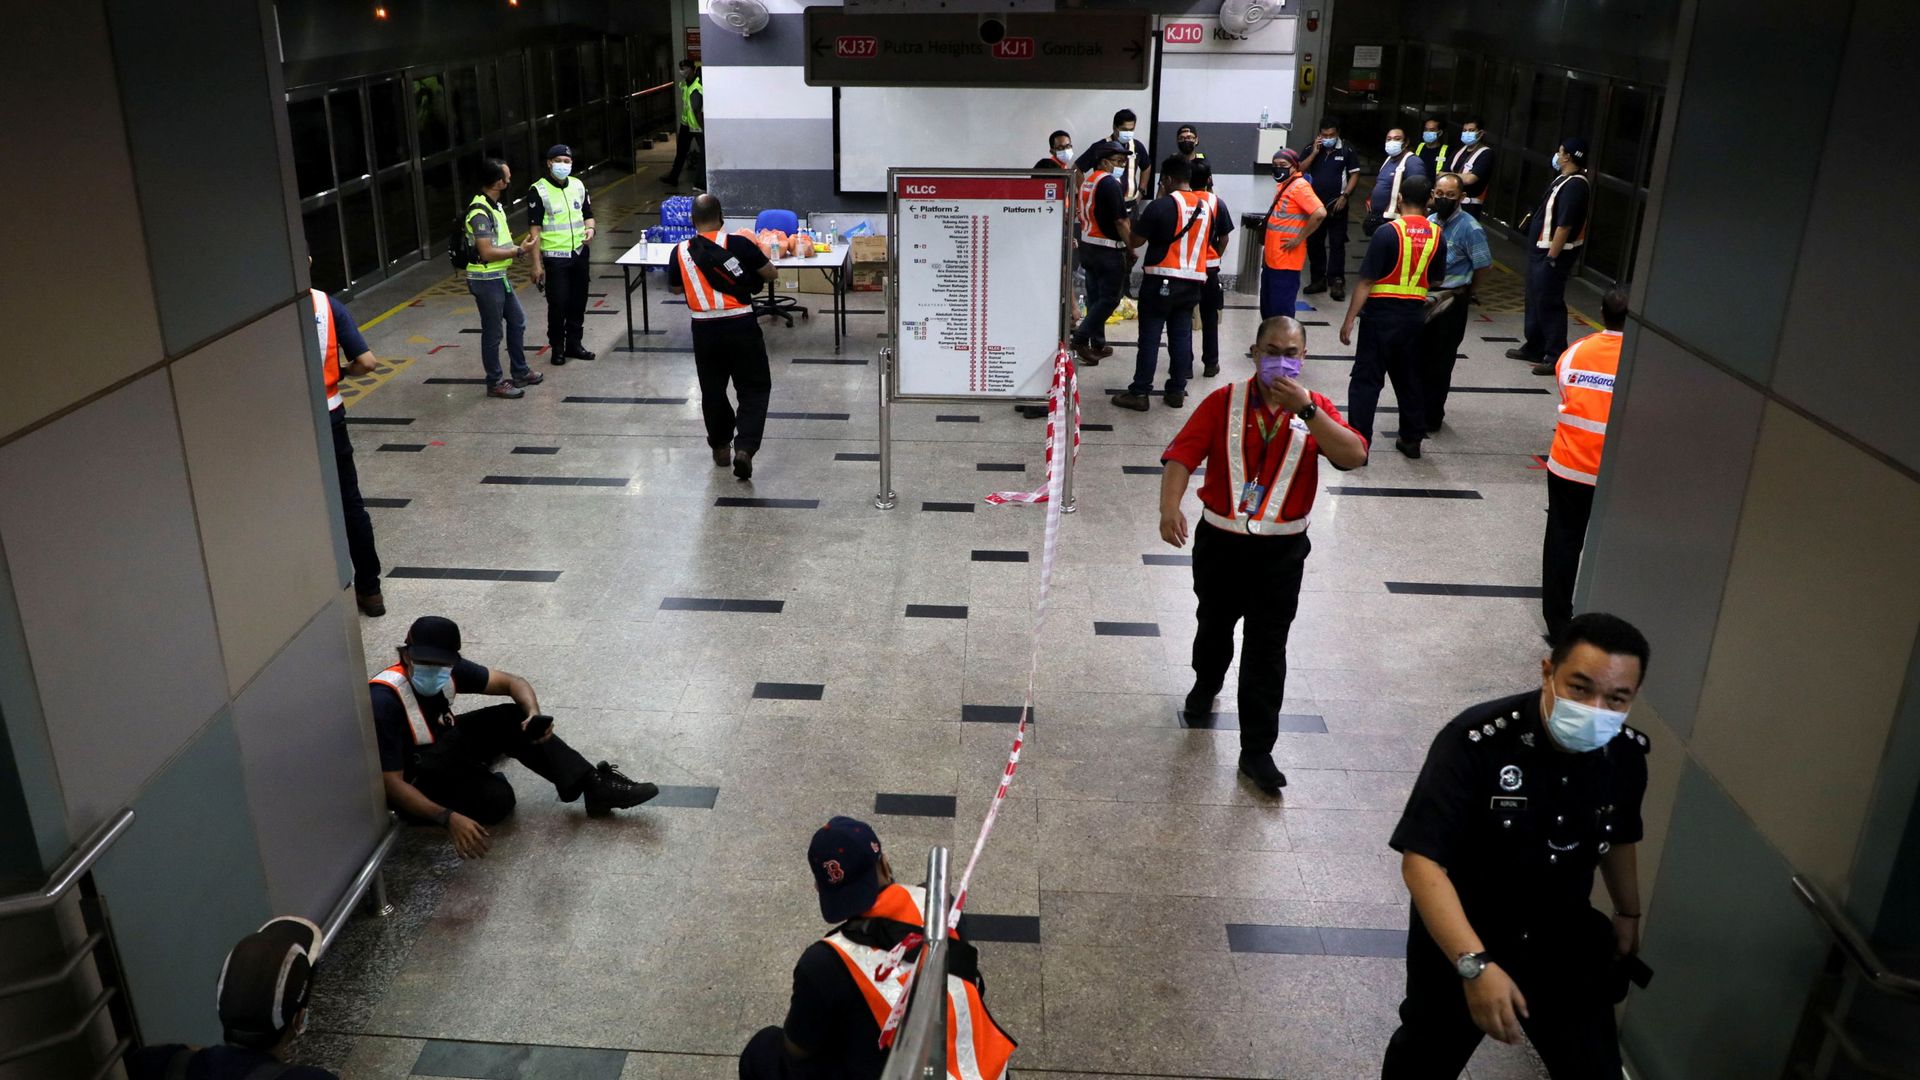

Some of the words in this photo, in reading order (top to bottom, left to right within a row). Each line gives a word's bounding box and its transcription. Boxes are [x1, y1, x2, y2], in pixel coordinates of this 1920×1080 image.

[1167, 27, 1201, 40] KJ10
[838, 40, 875, 54] KJ37
[883, 41, 923, 54] Putra
[928, 41, 983, 58] Heights
[1001, 41, 1027, 55] KJ1
[1043, 41, 1102, 56] Gombak
[906, 185, 936, 194] KLCC
[823, 859, 844, 882] B
